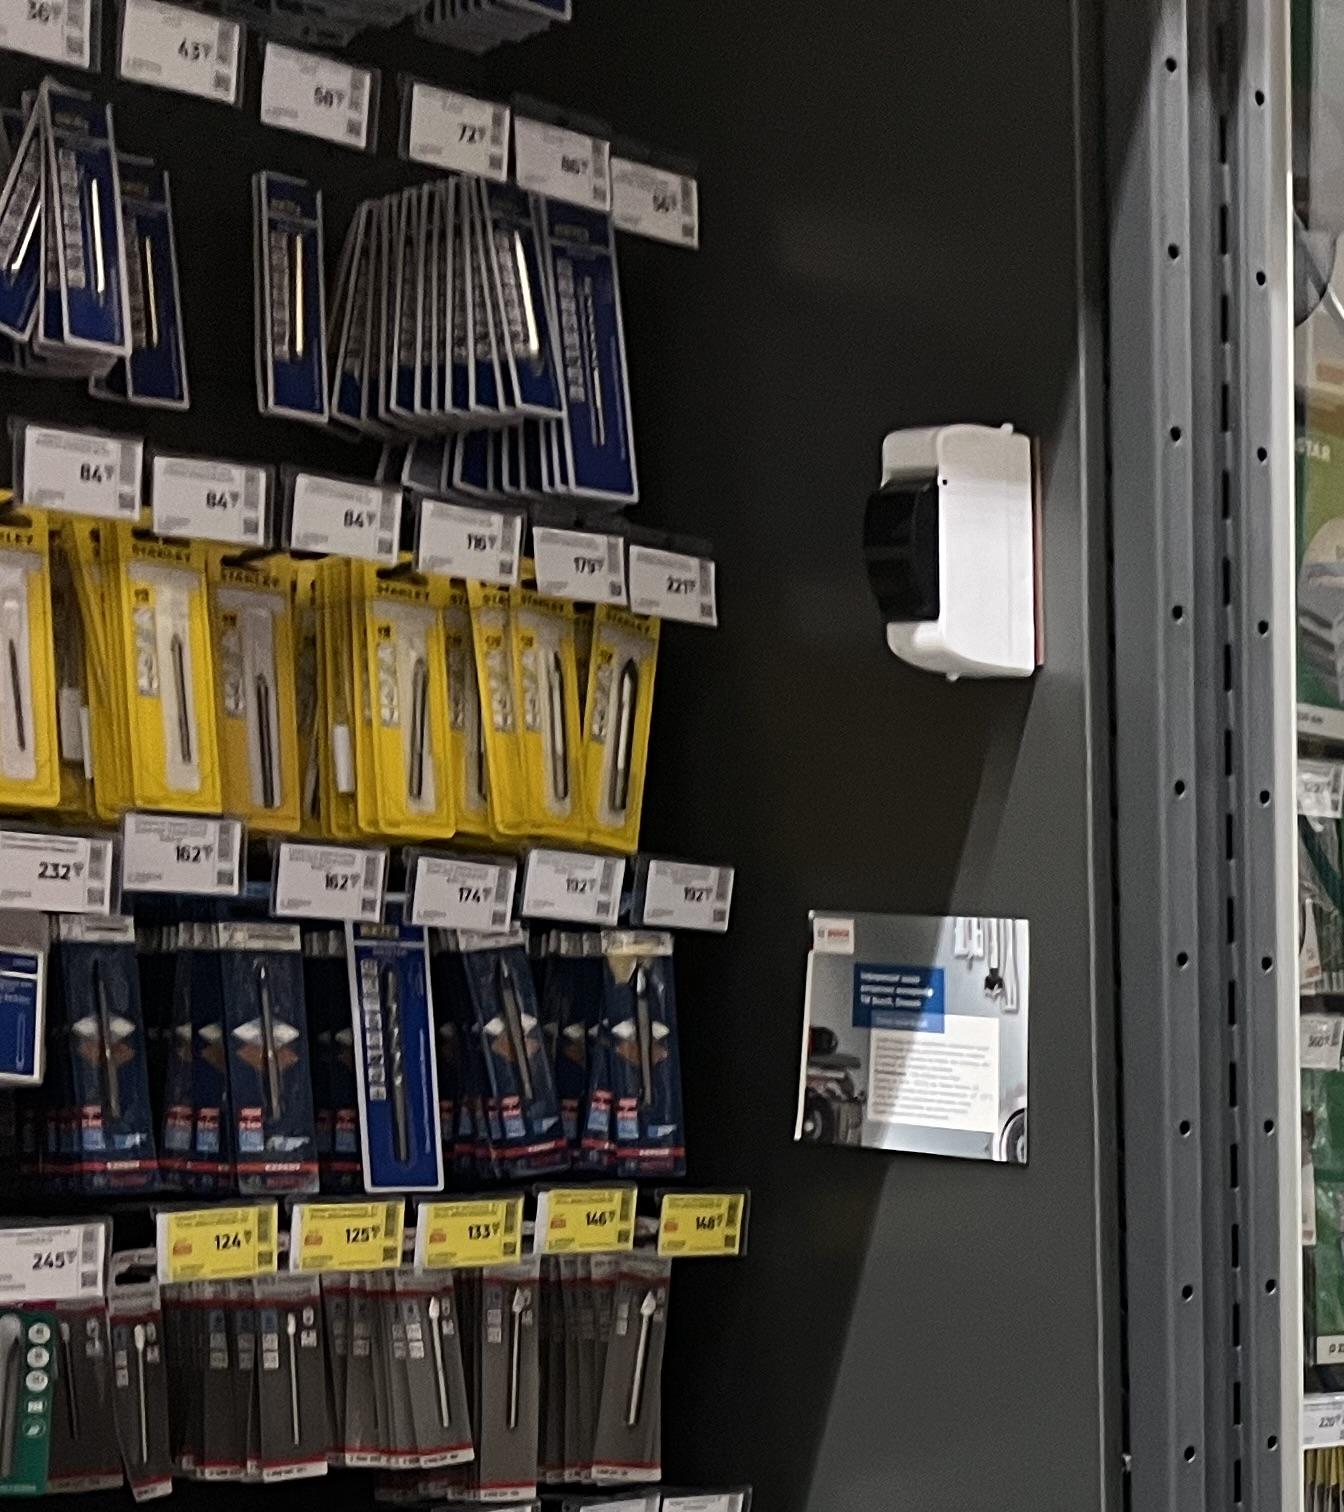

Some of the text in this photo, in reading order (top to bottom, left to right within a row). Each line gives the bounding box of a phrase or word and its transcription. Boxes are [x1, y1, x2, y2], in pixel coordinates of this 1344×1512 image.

[37, 862, 70, 880] 232
[345, 1227, 370, 1244] 125
[468, 1224, 490, 1240] 133
[214, 1233, 241, 1250] 124
[32, 1252, 65, 1271] 245
